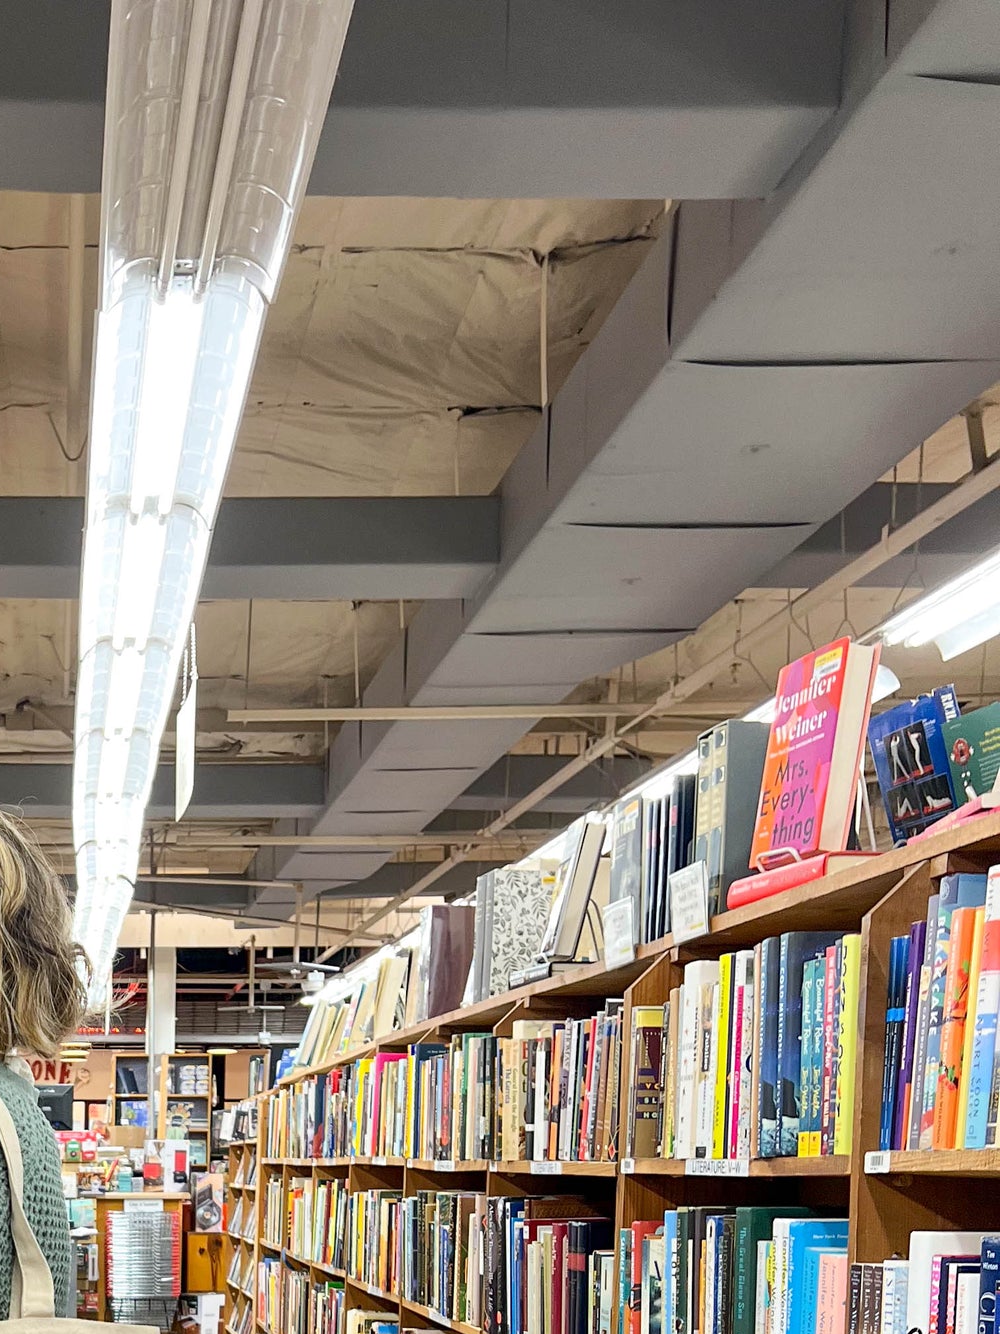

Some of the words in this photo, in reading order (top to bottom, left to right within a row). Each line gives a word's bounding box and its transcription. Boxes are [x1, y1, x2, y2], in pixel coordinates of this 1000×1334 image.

[775, 708, 828, 746] Weiner
[775, 757, 809, 787] Mrs.
[760, 783, 815, 818] Every-
[772, 814, 816, 847] thing
[935, 916, 948, 979] BLACK
[928, 986, 938, 1036] CAKE
[972, 1076, 981, 1118] SOON
[691, 1161, 727, 1174] LITERATURE:
[787, 1236, 795, 1286] Jennifer
[982, 1261, 999, 1272] Winton
[820, 1262, 828, 1305] Jennifer
[884, 1278, 893, 1331] STILL
